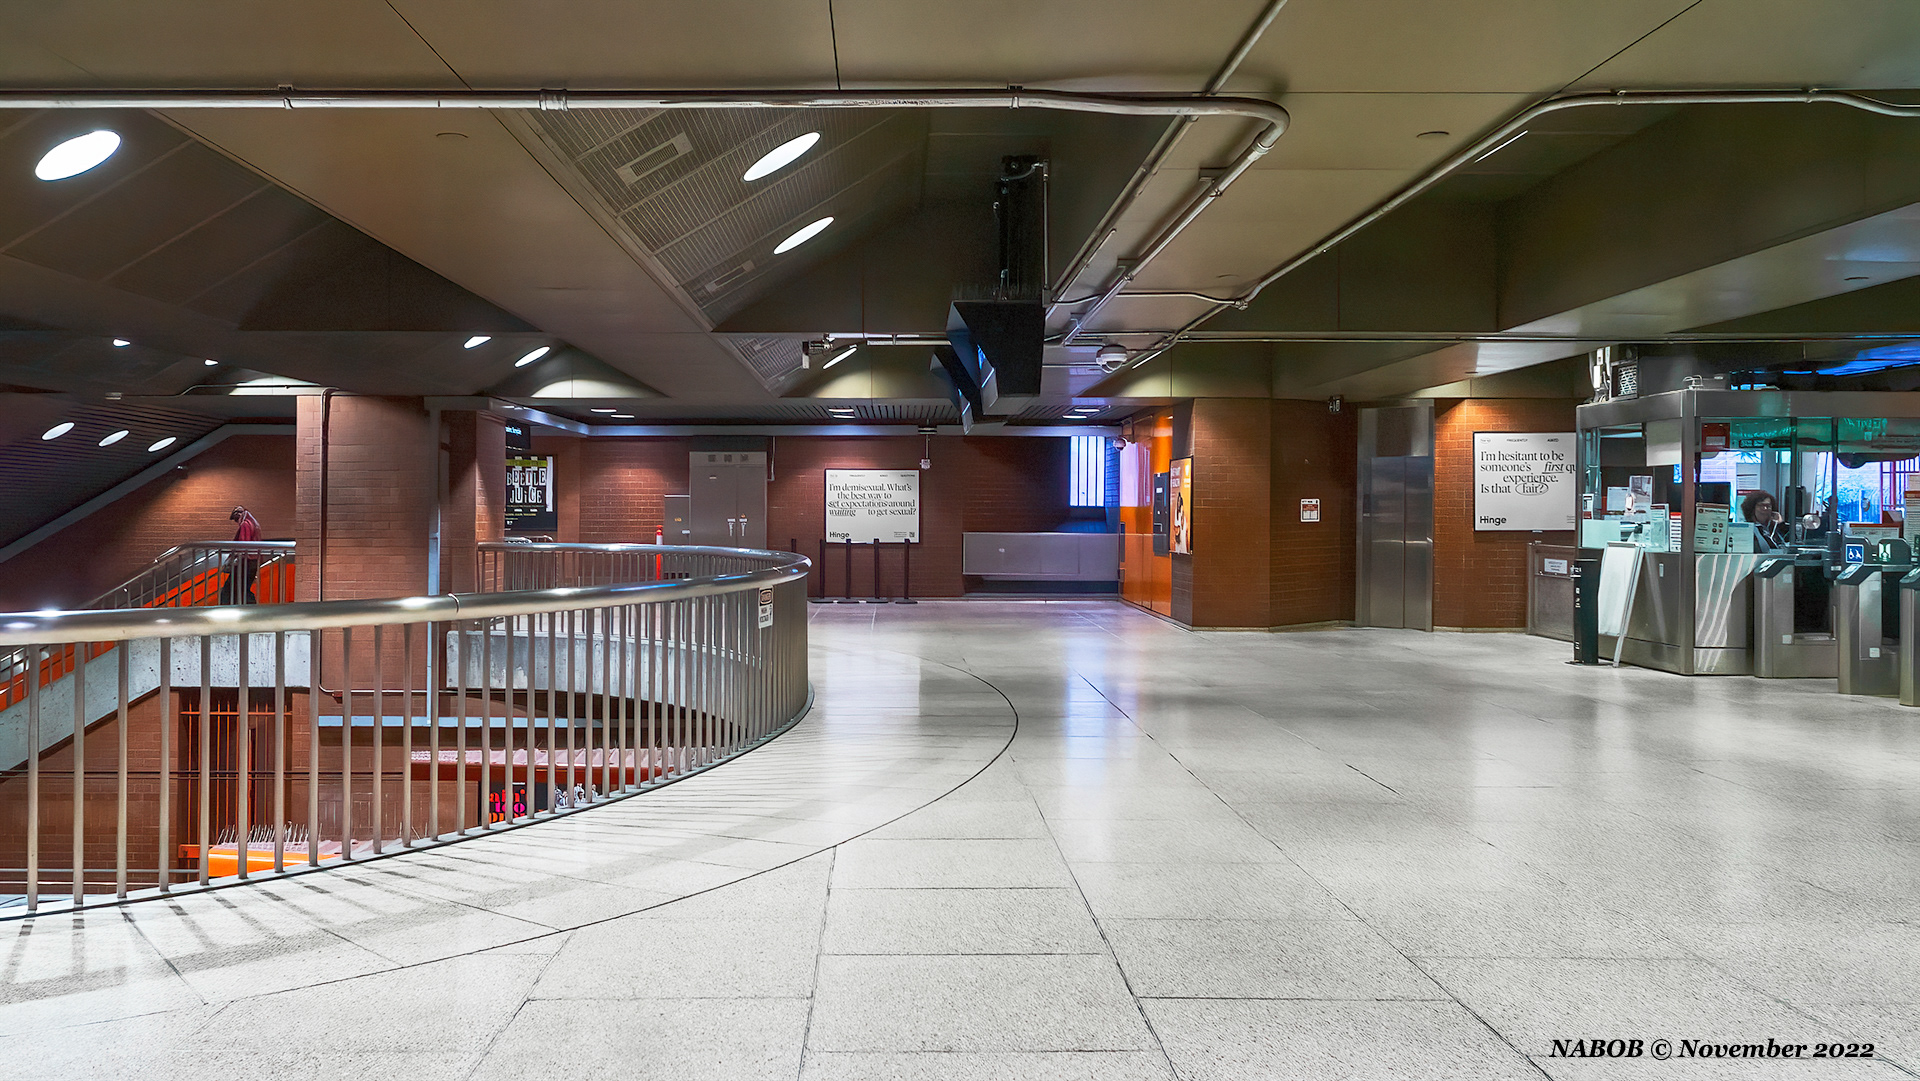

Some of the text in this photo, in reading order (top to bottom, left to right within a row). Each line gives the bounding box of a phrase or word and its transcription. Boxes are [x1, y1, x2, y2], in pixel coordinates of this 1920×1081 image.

[1480, 450, 1564, 461] I'm hesitant to be
[1480, 462, 1532, 472] someone's
[1544, 462, 1564, 473] first
[506, 468, 546, 486] BEETLE
[1503, 472, 1558, 484] experience.
[1480, 483, 1544, 494] Is that fair?
[841, 500, 887, 509] expectations
[888, 500, 916, 508] around
[1480, 516, 1506, 526] Hinge
